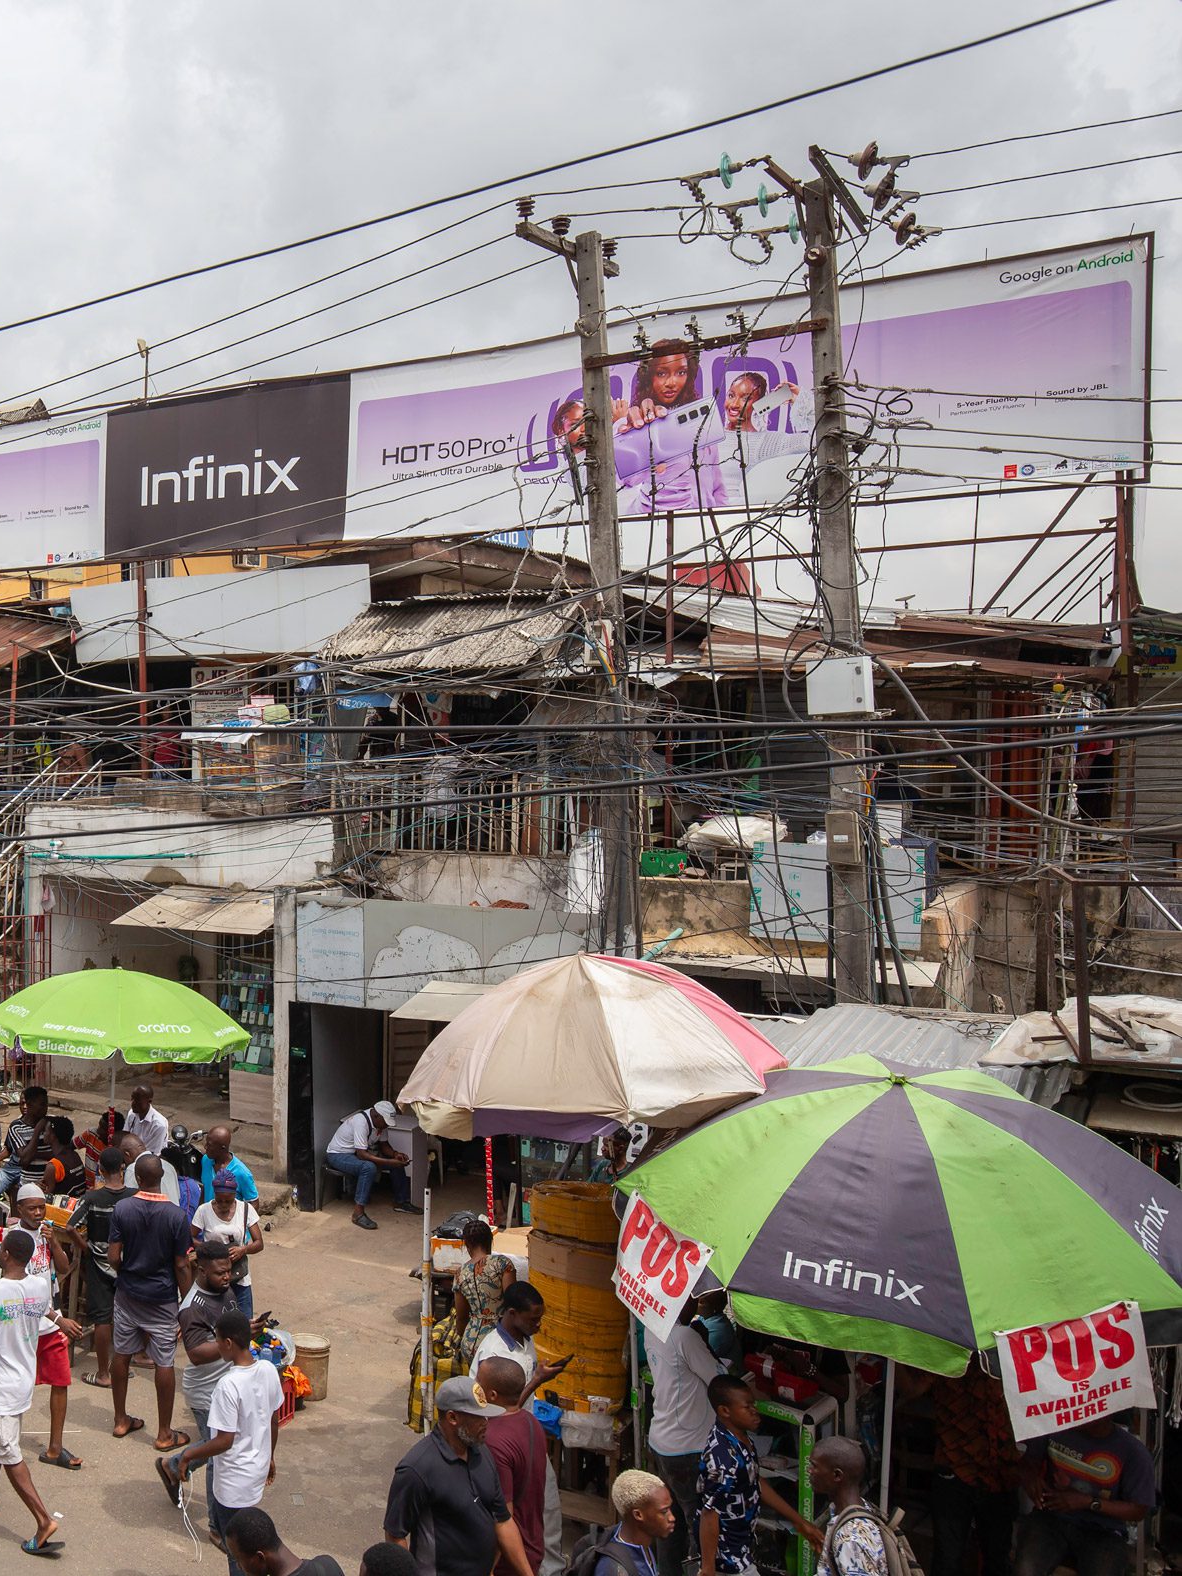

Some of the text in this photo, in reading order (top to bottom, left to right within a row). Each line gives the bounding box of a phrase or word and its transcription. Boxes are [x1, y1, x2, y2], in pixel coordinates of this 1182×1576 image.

[999, 250, 1134, 284] Google on Android
[1046, 383, 1109, 397] Sound by JBL
[950, 408, 988, 416] Performance
[1002, 402, 1025, 410] Fluency
[957, 396, 1019, 408] 5-Year Fluency
[46, 427, 68, 436] Google
[77, 421, 102, 431] Android
[141, 448, 302, 507] Infinix
[392, 471, 414, 481] Ultra
[440, 467, 463, 476] Ultra
[465, 463, 503, 474] Durable
[5, 1003, 30, 1018] oraimo
[43, 1022, 107, 1038] Keep Exploring
[137, 1023, 192, 1034] oraimo
[38, 1039, 95, 1057] Bluetooth
[149, 1048, 192, 1061] Charger
[620, 1198, 701, 1299] POS
[637, 1271, 649, 1285] IS
[782, 1250, 924, 1307] Infinix
[619, 1283, 648, 1317] HERE
[1007, 1302, 1136, 1394] POS
[1072, 1380, 1090, 1394] IS
[1025, 1376, 1133, 1418] AVAILABLE
[1056, 1400, 1108, 1427] HERE
